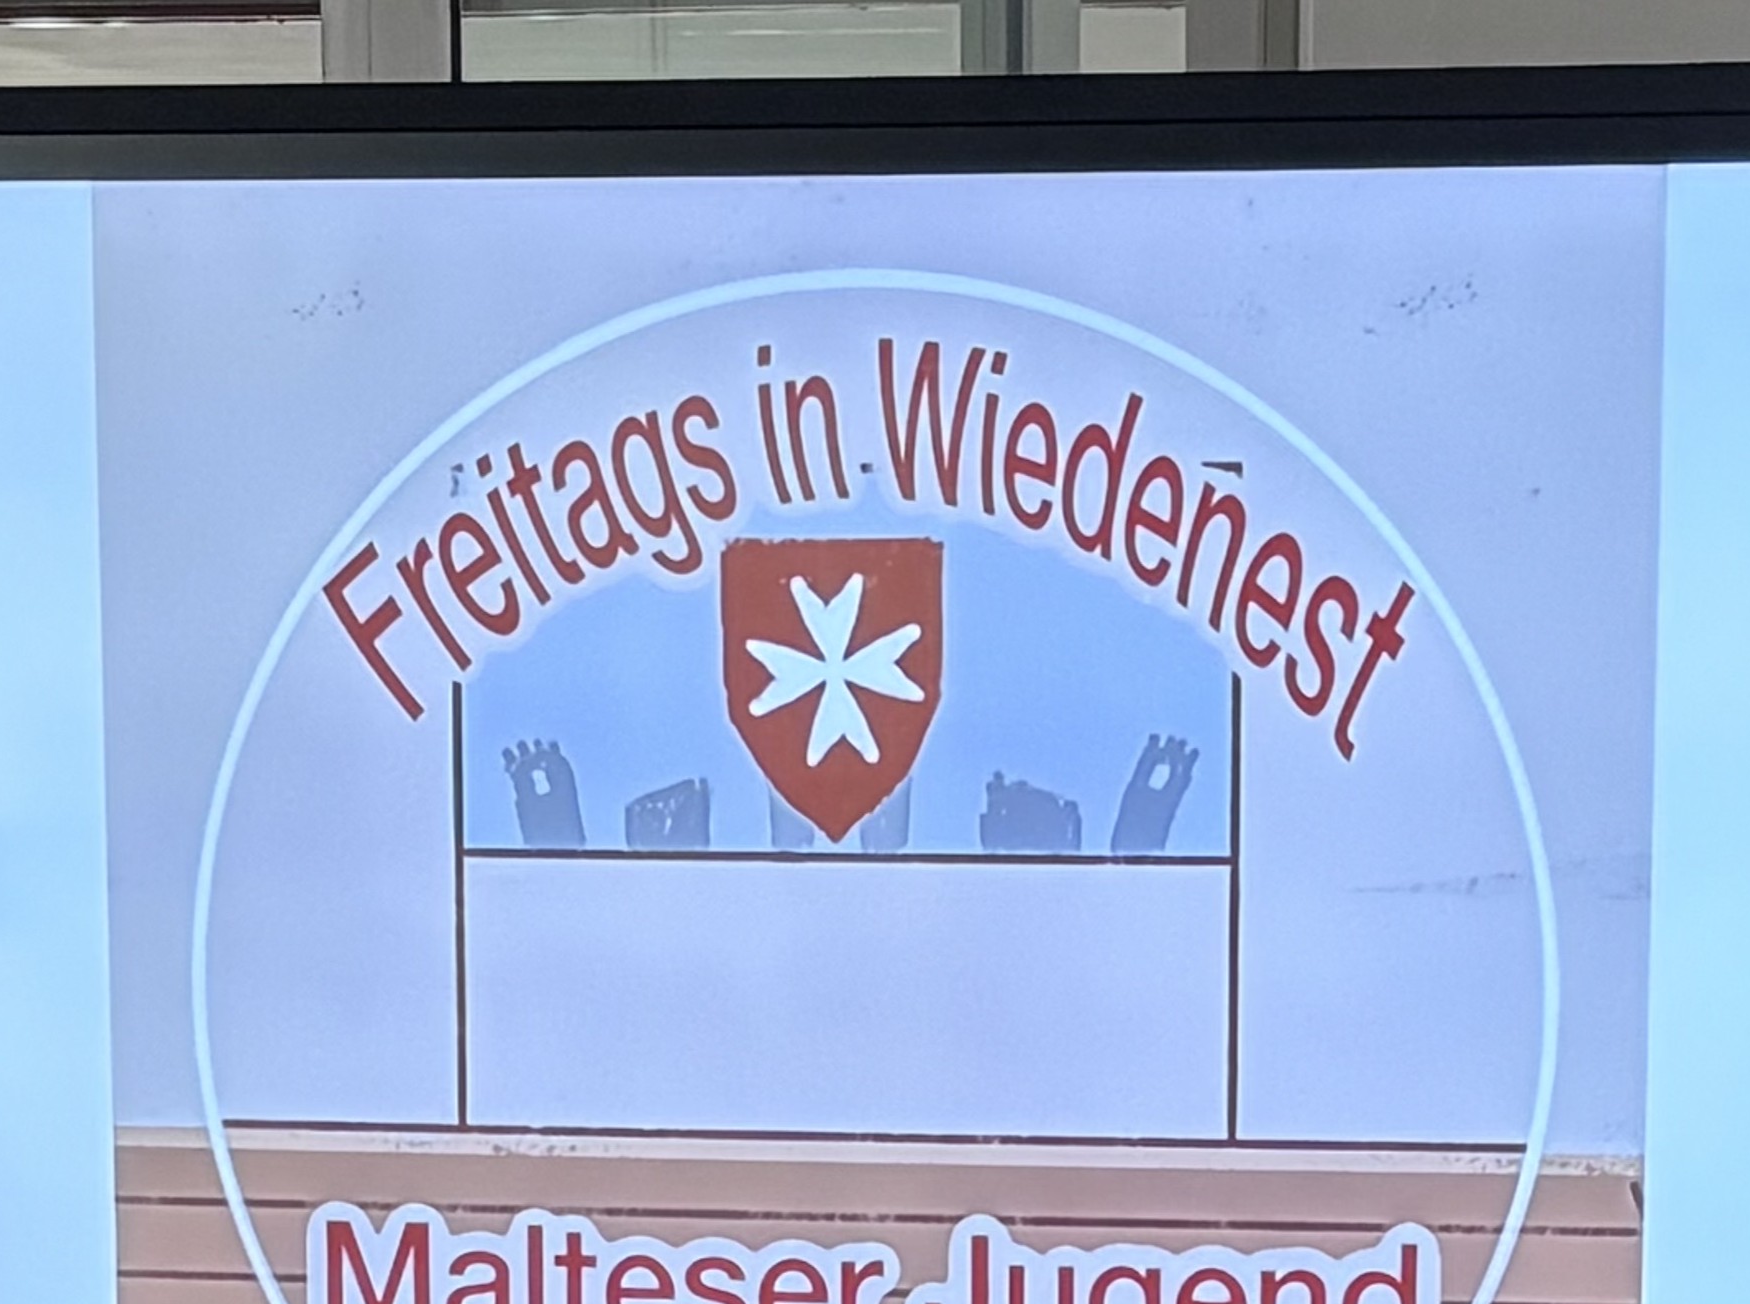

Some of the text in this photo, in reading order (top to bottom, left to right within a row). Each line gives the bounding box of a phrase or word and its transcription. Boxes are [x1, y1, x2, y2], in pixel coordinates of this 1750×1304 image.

[323, 337, 1416, 762] Freitags in Wiedenest
